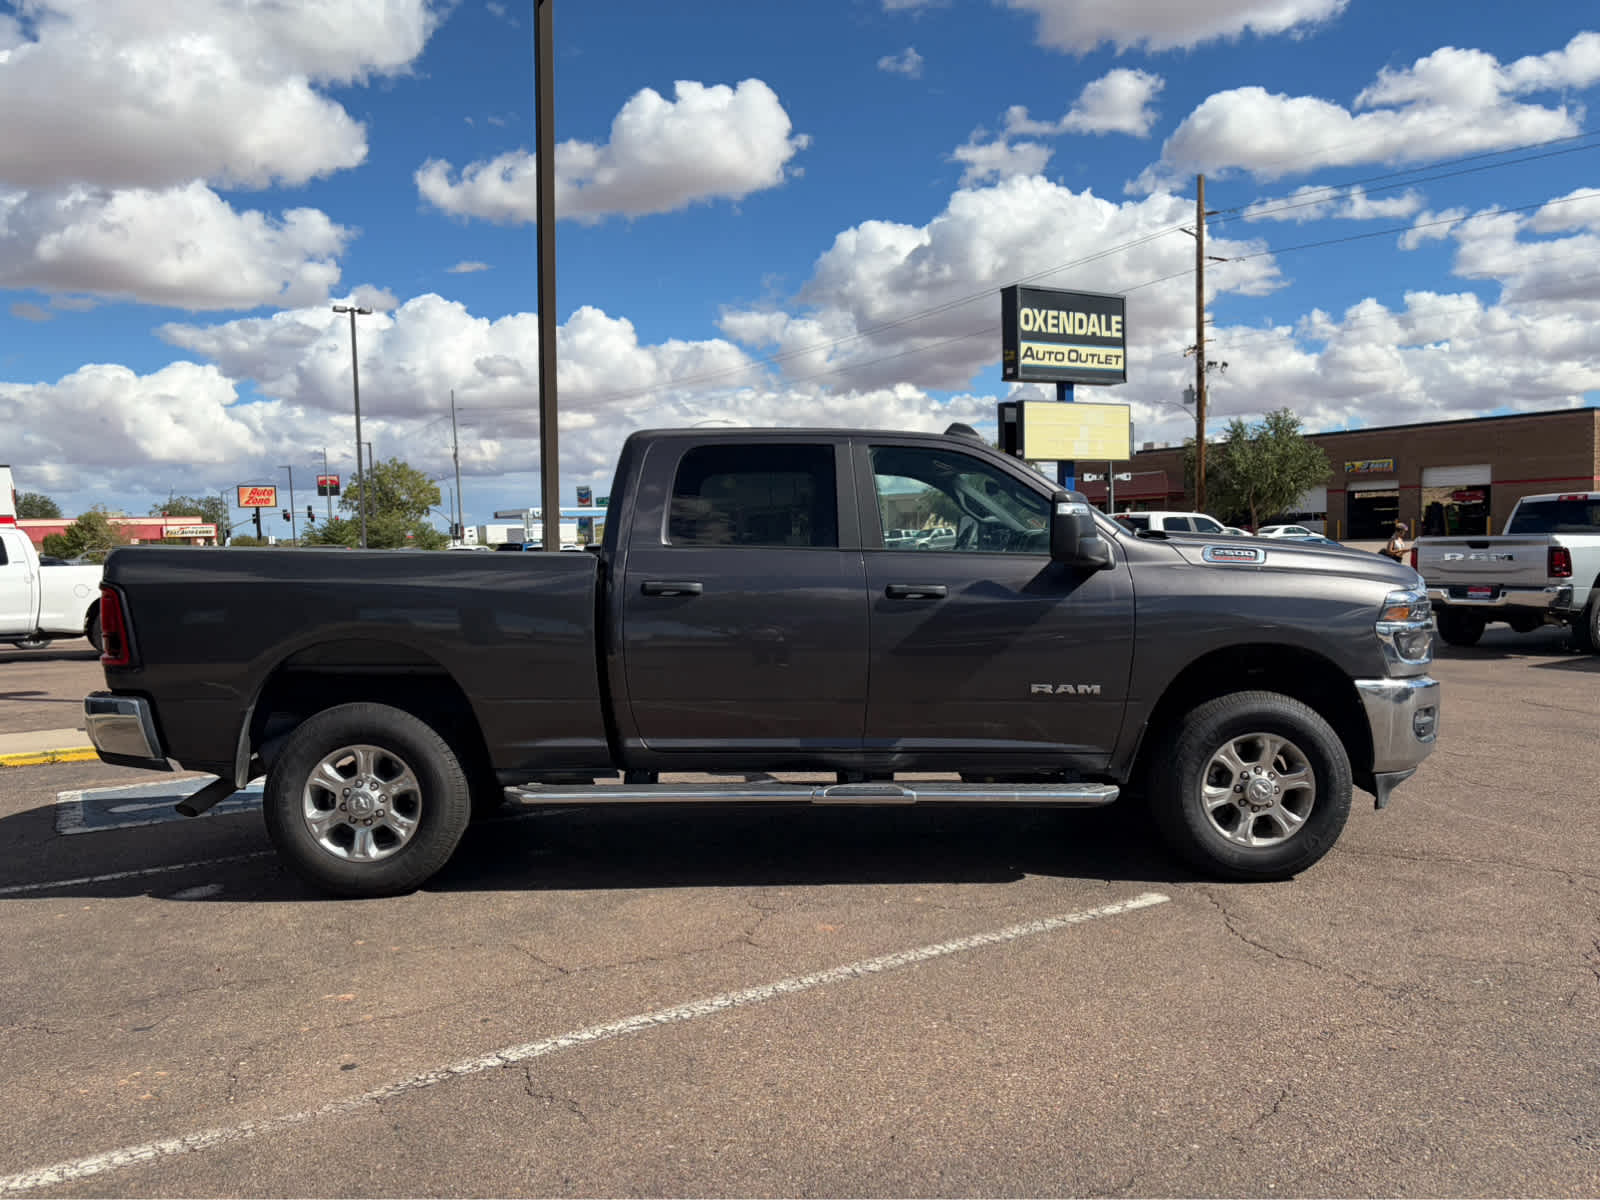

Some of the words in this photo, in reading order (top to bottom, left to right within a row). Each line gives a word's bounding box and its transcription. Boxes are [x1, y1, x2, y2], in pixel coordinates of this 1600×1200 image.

[1020, 307, 1123, 338] OXENDALE
[1022, 346, 1065, 362] AUTO
[1067, 349, 1122, 365] OUTLET
[1031, 684, 1101, 695] RAM
